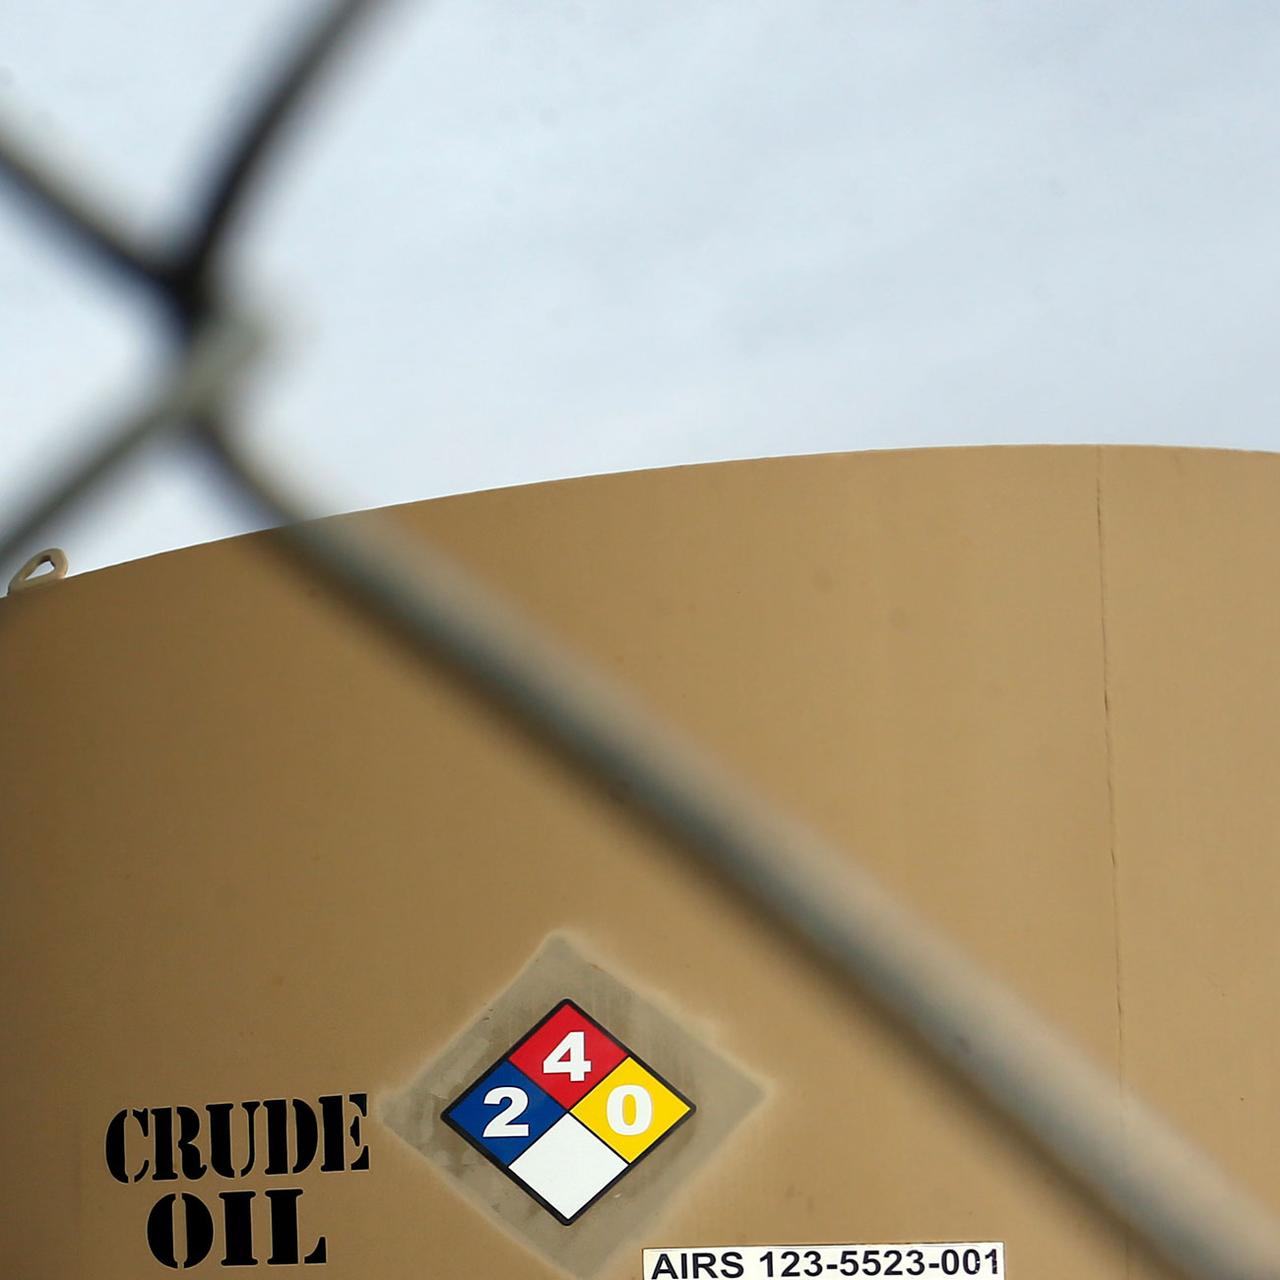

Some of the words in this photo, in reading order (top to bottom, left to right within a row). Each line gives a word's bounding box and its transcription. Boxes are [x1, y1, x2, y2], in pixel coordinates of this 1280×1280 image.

[544, 1032, 590, 1082] 4
[483, 1086, 529, 1137] 2
[607, 1085, 652, 1136] 0
[106, 1094, 370, 1184] CRUDE
[147, 1189, 327, 1269] OIL
[652, 1247, 744, 1280] AIRS
[759, 1244, 1000, 1279] 123-5523-001
